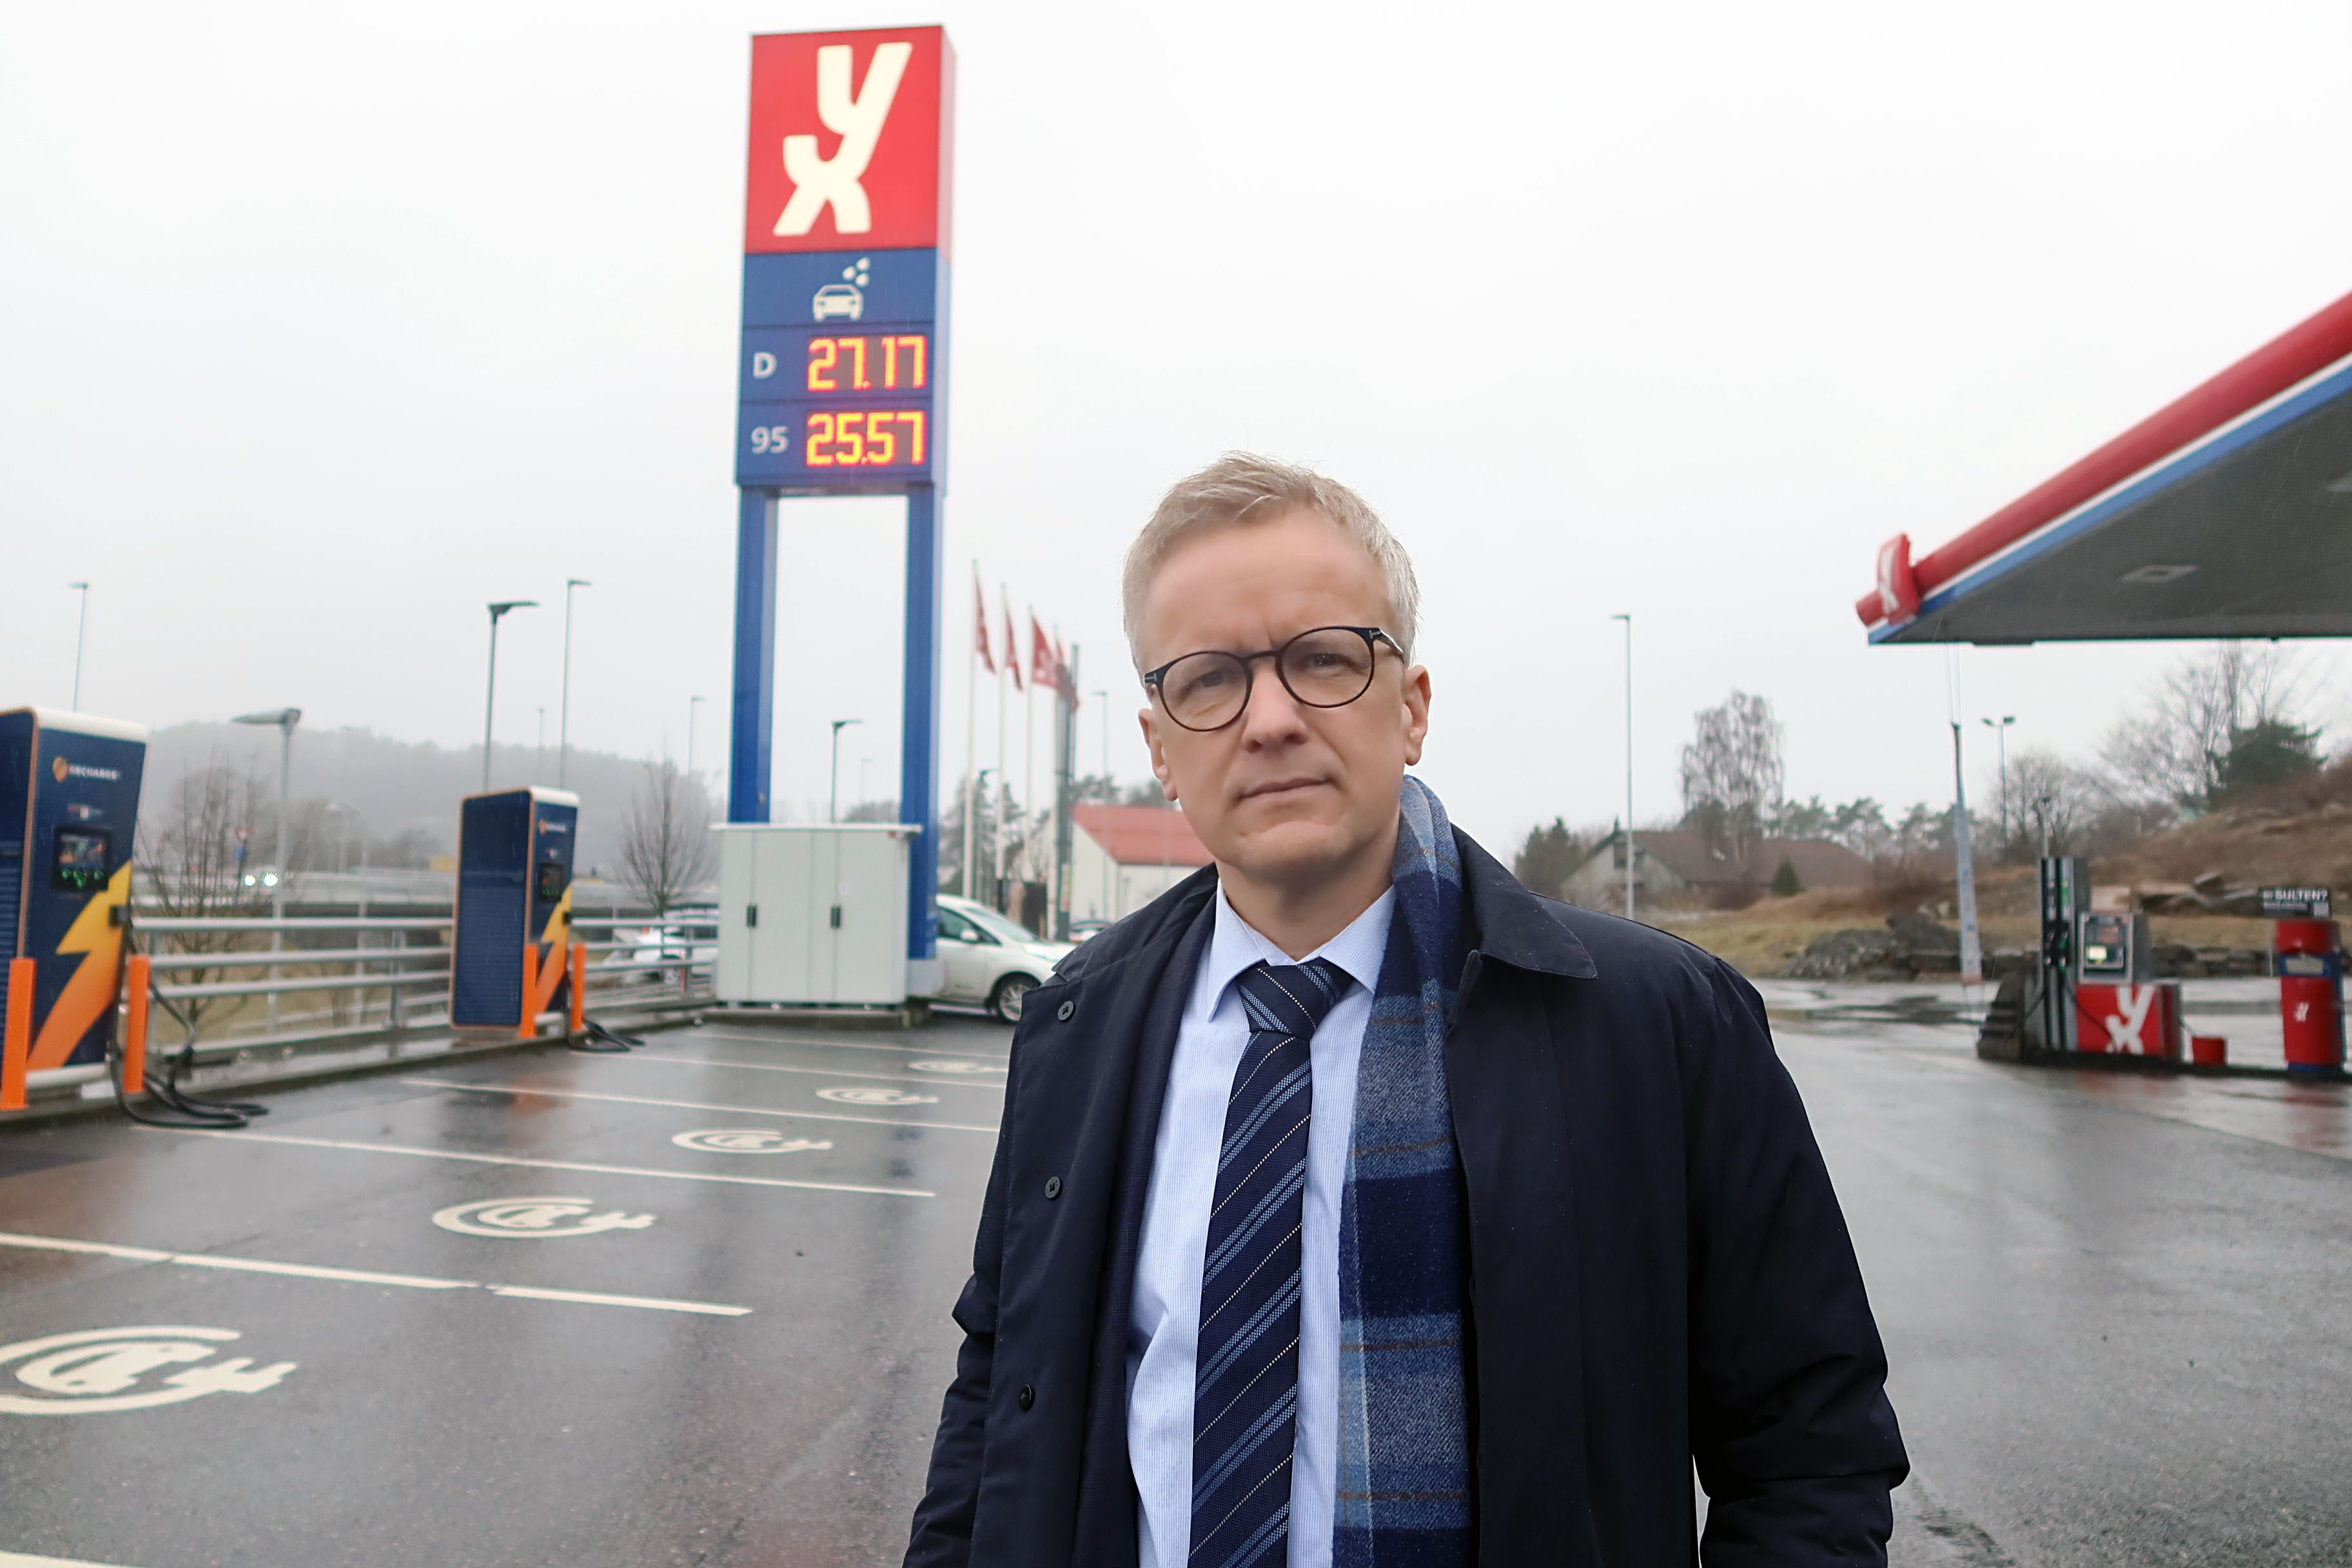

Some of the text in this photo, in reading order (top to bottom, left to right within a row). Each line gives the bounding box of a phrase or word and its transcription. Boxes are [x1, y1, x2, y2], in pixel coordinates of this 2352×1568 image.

[753, 335, 926, 392] D 27.17
[751, 411, 926, 467] 95 25.57
